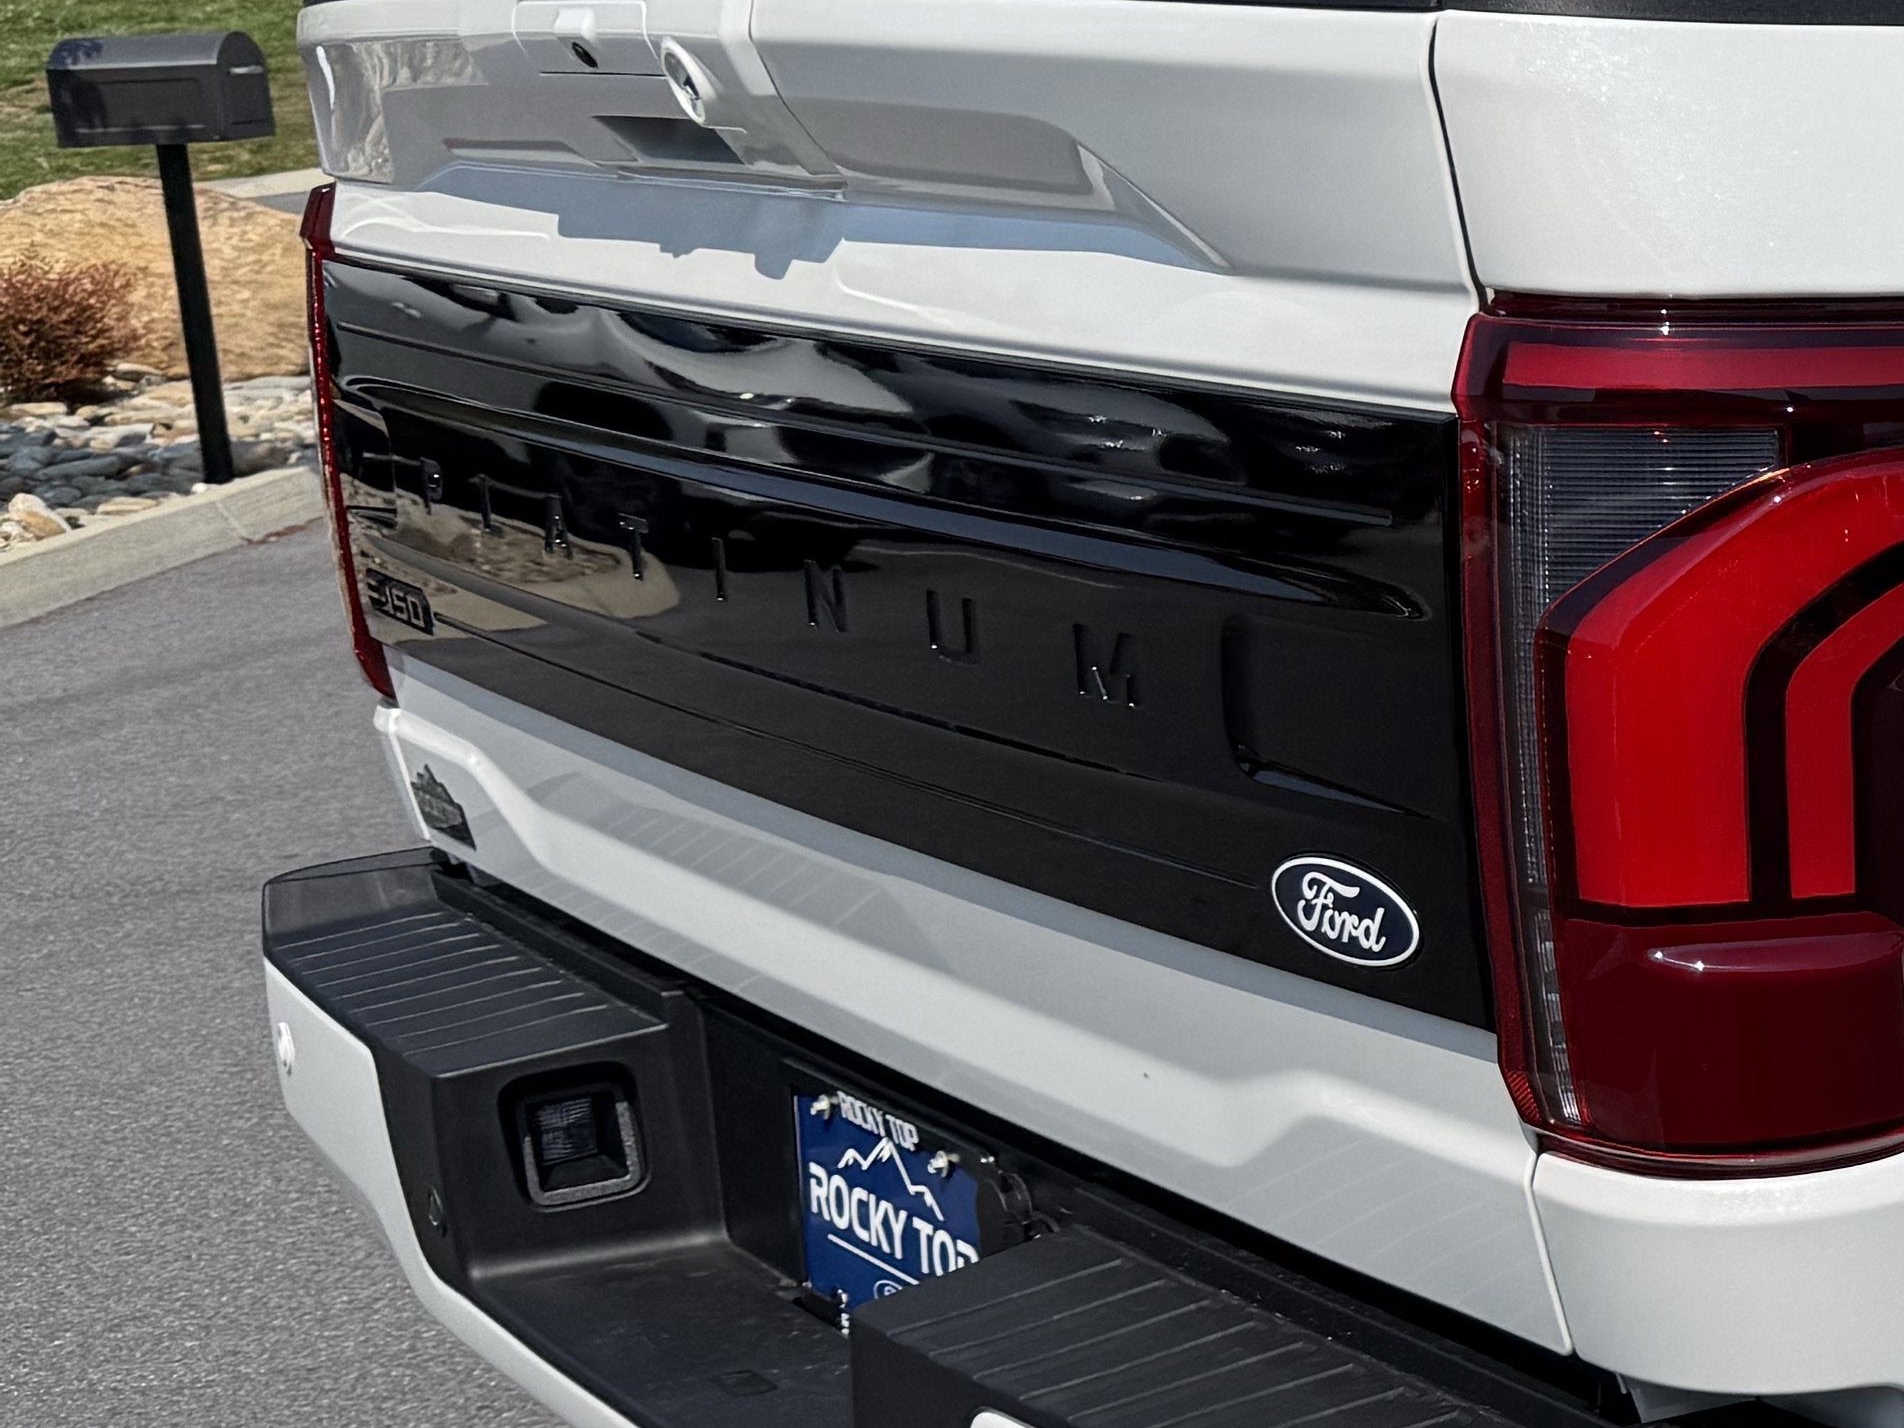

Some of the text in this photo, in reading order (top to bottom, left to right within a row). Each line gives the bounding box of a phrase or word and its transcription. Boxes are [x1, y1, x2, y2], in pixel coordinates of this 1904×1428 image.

[1297, 871, 1386, 953] Ford
[837, 1090, 920, 1153] ROCKY TOP
[808, 1162, 909, 1260] ROCKY
